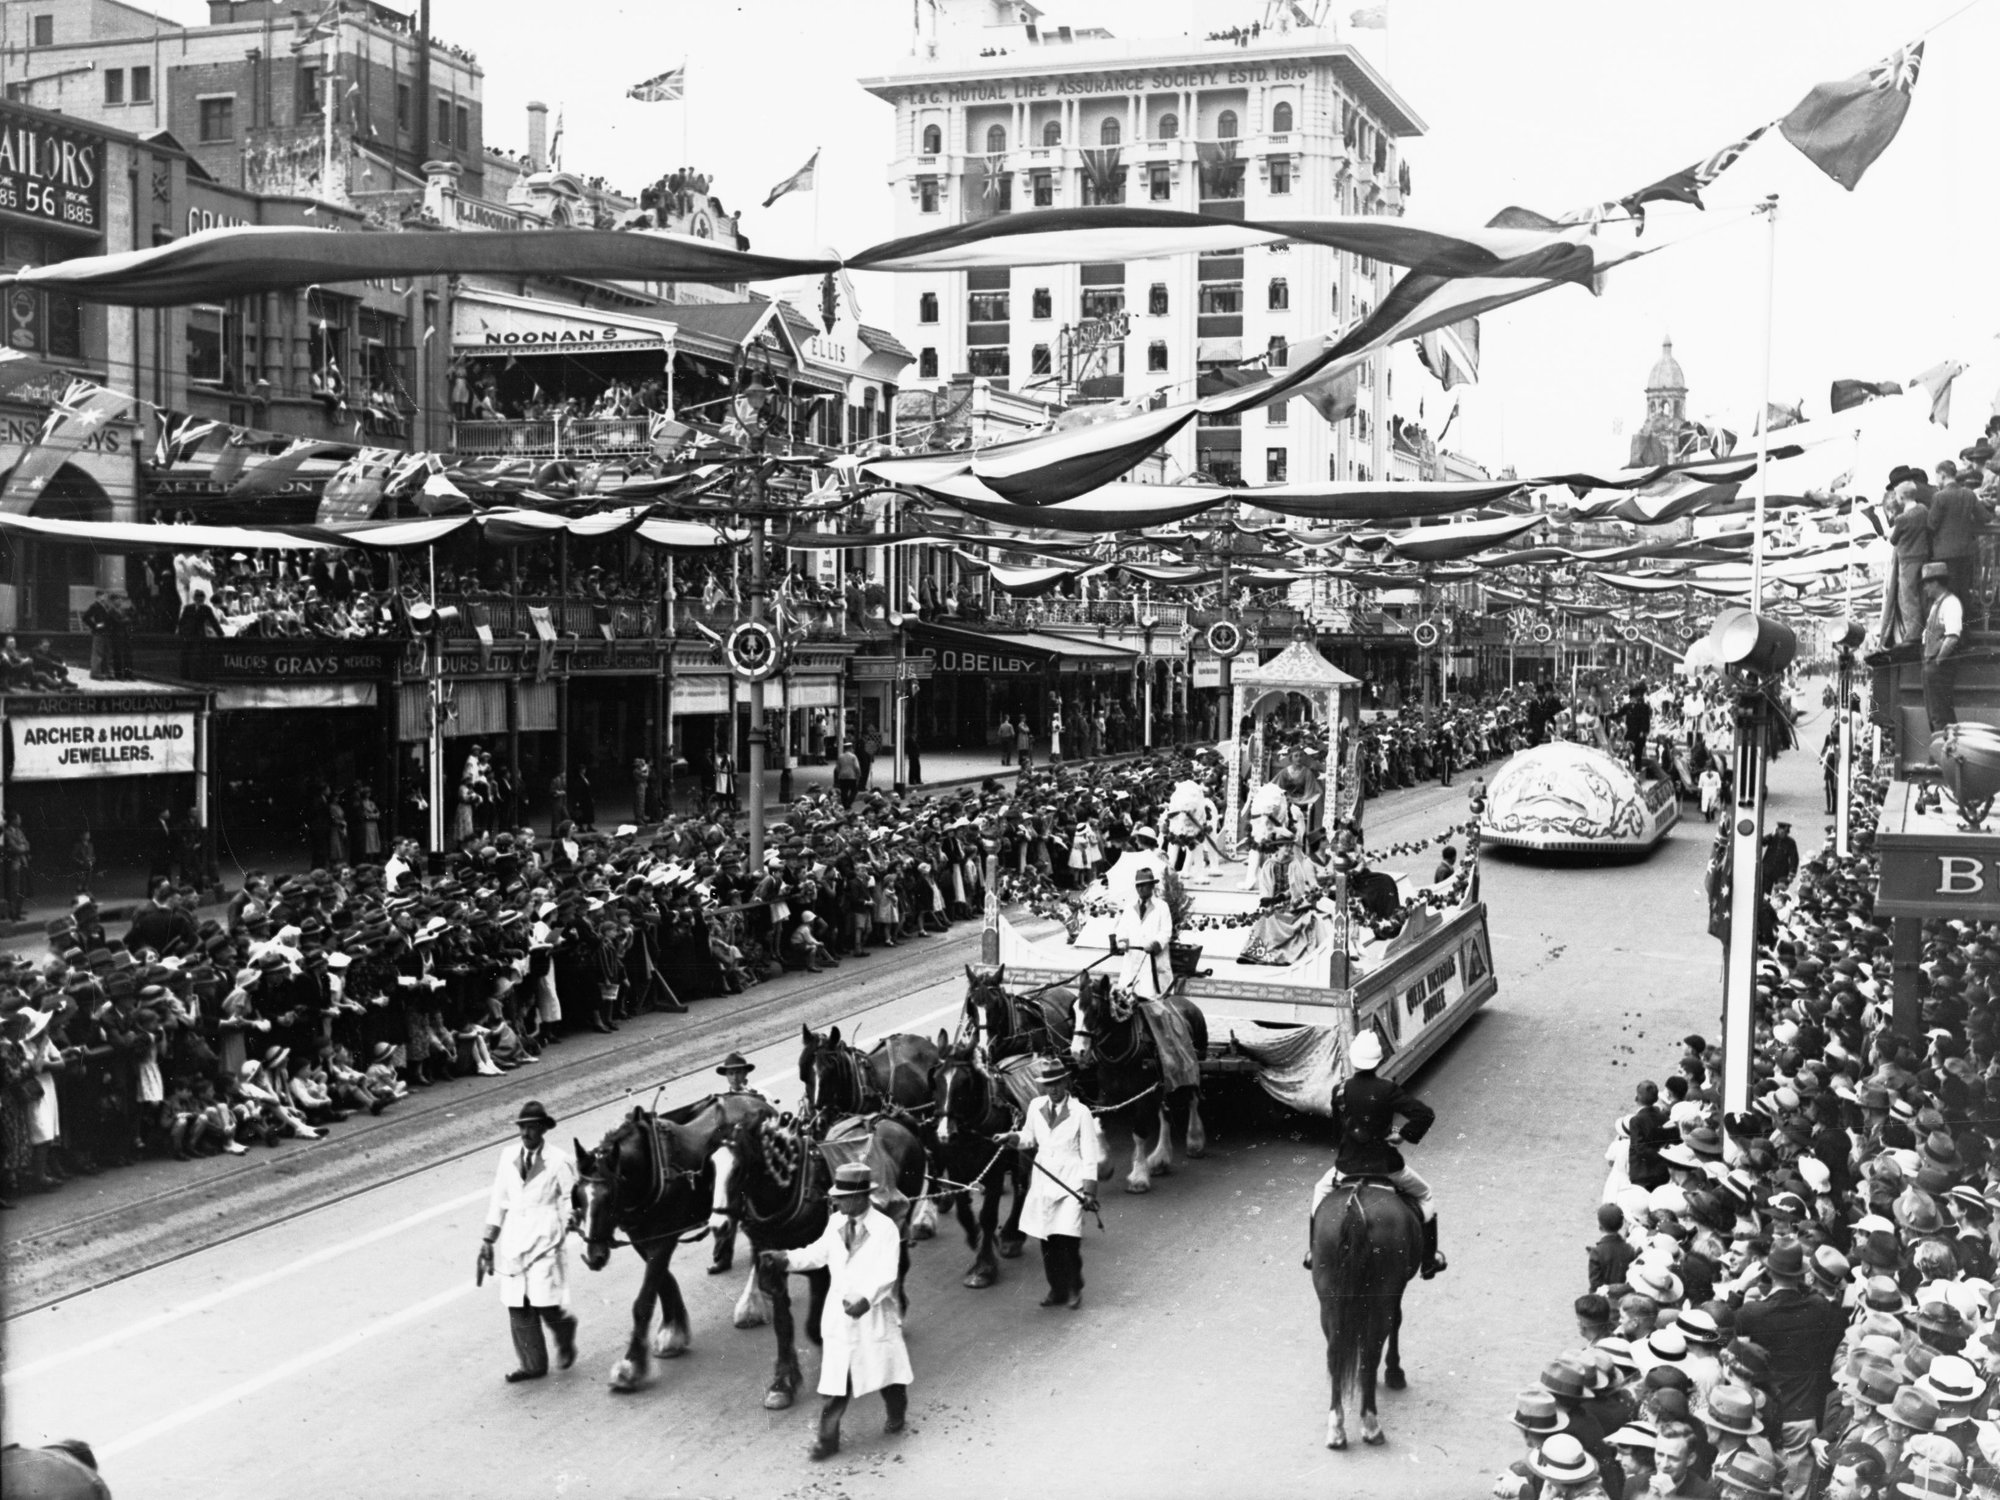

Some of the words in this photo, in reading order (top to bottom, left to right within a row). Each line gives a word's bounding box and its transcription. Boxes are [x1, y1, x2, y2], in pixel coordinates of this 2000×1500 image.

[950, 87, 1007, 102] MUTUAL
[1014, 83, 1047, 98] LIFE
[1056, 76, 1145, 96] ASSURANCE
[26, 182, 55, 216] 56
[63, 202, 93, 224] 1885
[811, 337, 846, 363] ELLIS
[156, 481, 313, 494] AFTERON
[223, 654, 268, 669] TAILORS
[275, 656, 339, 674] GRAYS
[37, 697, 97, 713] ARCHER
[111, 696, 173, 711] HOLLAND
[24, 726, 95, 746] ARCHER
[98, 730, 108, 743] &
[110, 724, 184, 742] HOLLAND
[58, 745, 154, 765] JEWELLERS.
[1936, 856, 2000, 894] B
